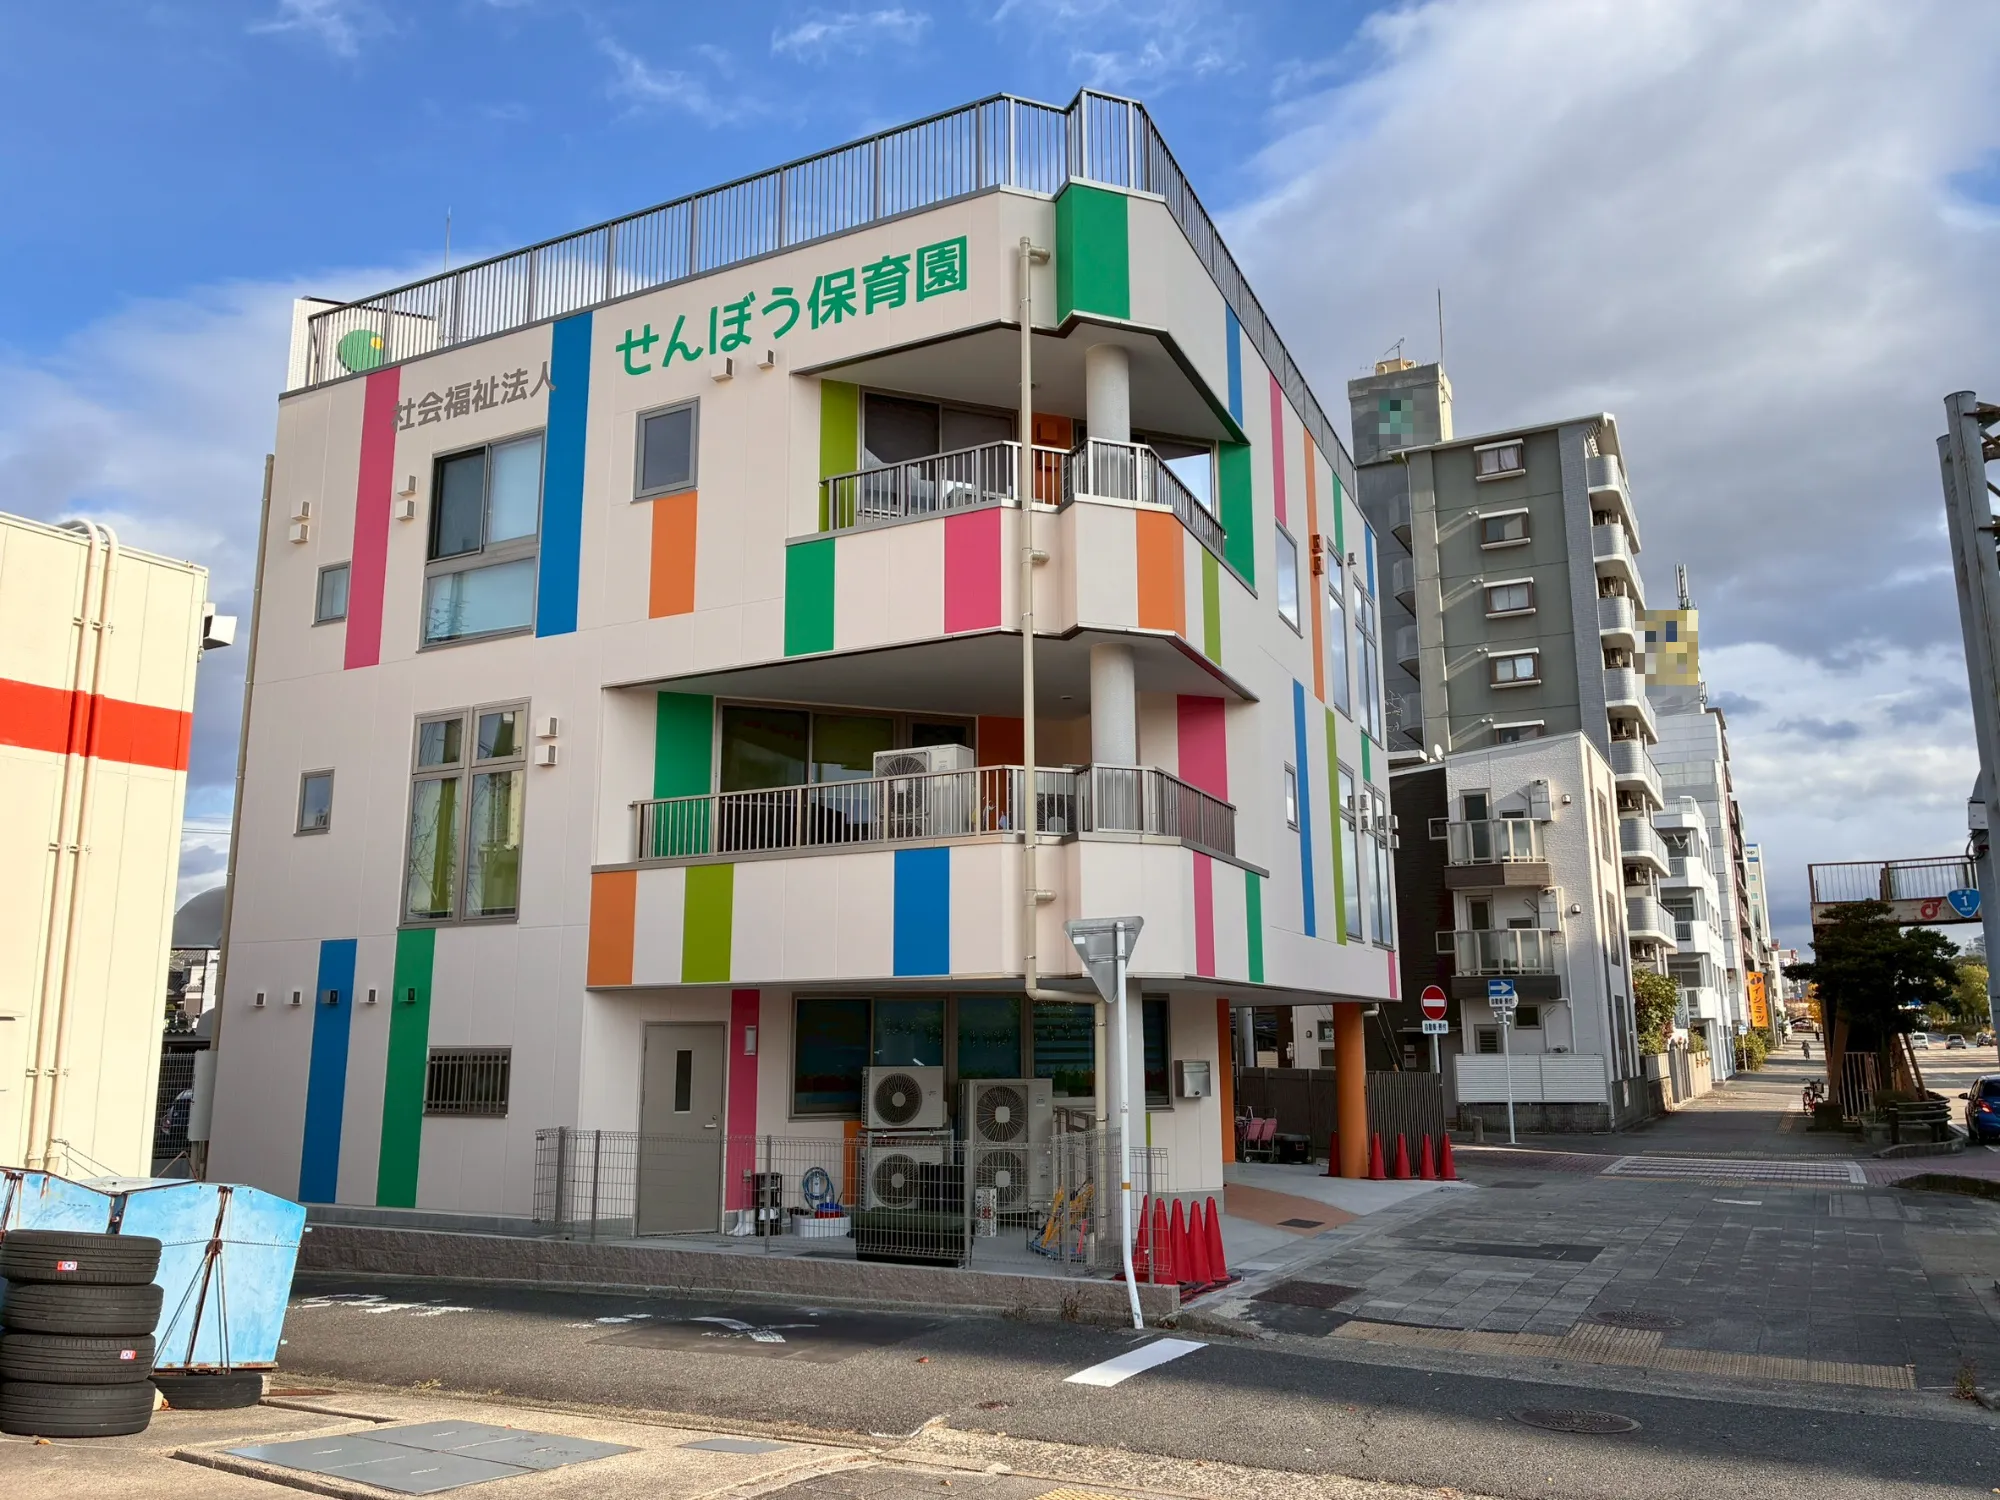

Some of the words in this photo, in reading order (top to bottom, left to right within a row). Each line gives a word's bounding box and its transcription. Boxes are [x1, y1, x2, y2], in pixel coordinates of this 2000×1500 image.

[616, 236, 968, 376] せんぼう保育園
[391, 360, 556, 430] 社会福祉法人
[1961, 895, 1968, 907] 1
[1753, 986, 1765, 1023] イシミツ
